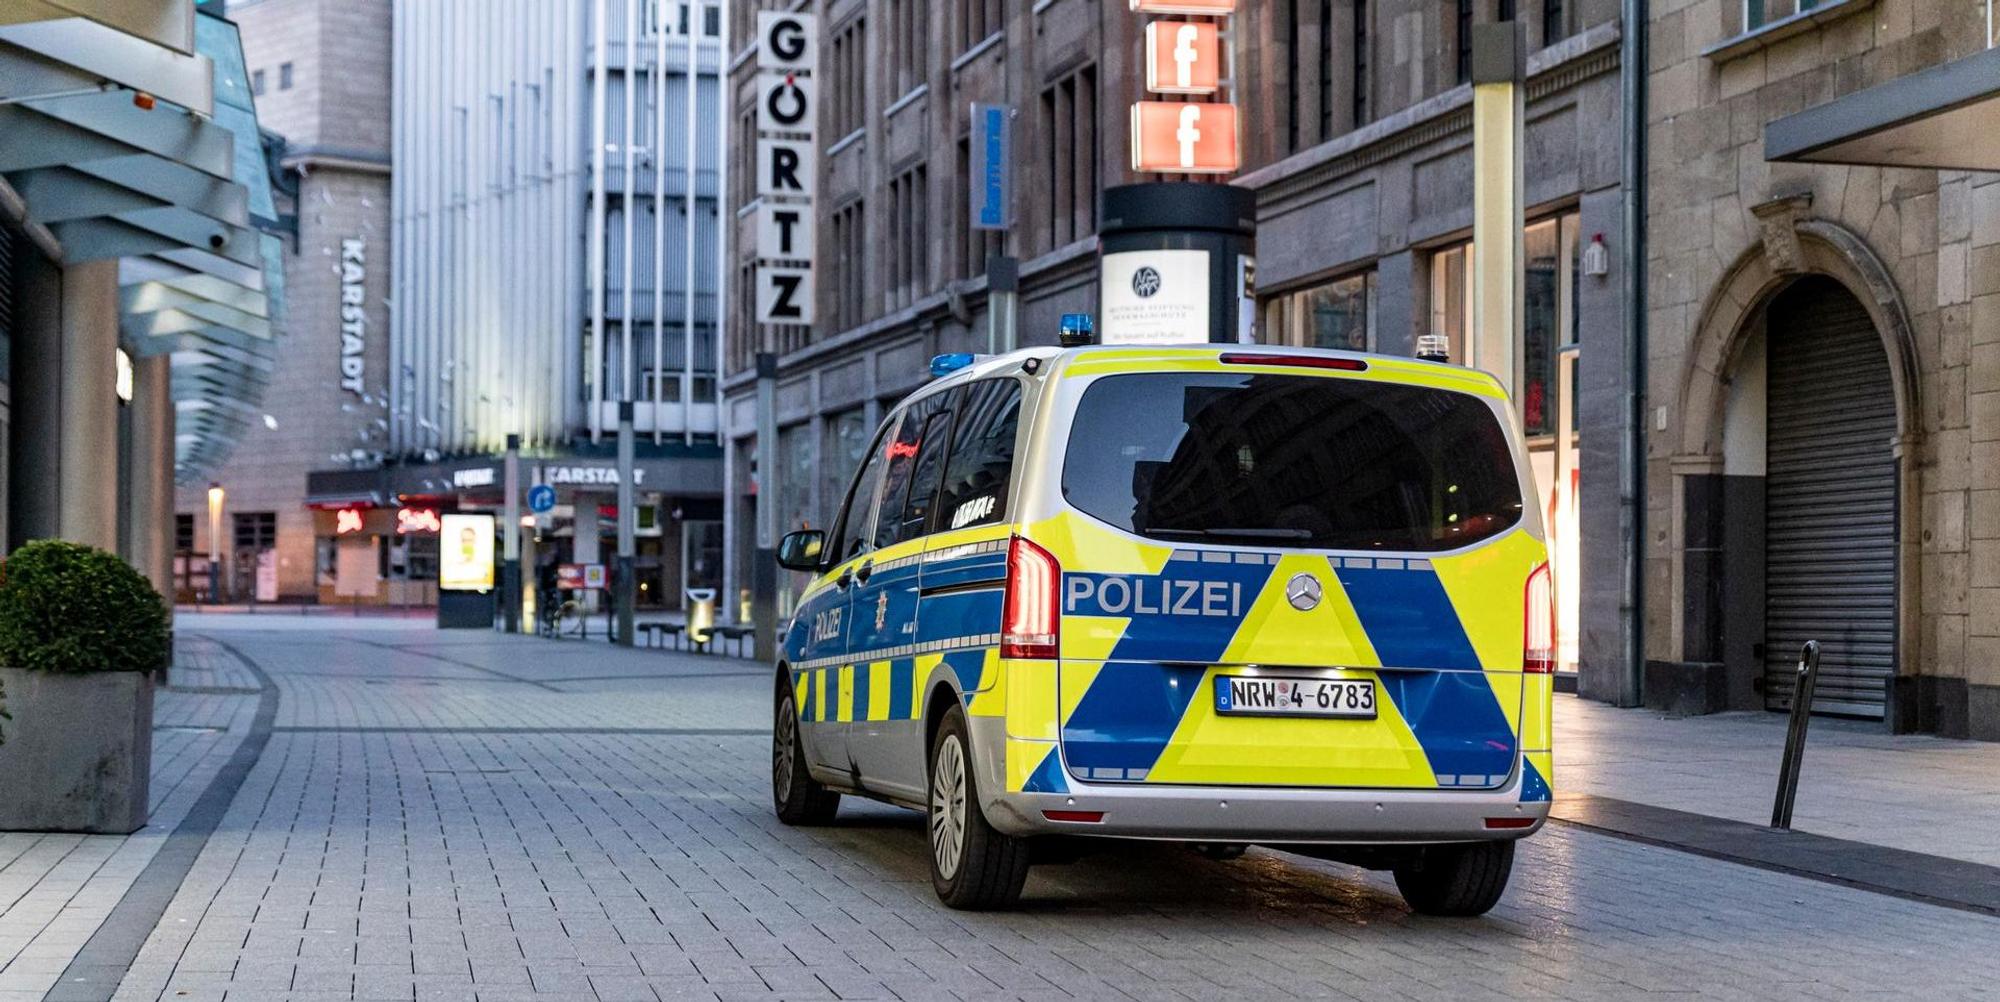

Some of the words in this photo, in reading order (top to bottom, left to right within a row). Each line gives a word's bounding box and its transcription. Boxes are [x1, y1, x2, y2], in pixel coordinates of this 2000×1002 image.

[1173, 24, 1198, 87] f
[1176, 104, 1200, 168] f
[341, 238, 365, 392] KARSTADT
[546, 466, 645, 484] KARSTAT
[1067, 576, 1241, 617] POLIZEI
[1221, 696, 1228, 705] D
[1231, 681, 1275, 707] NRW
[1291, 683, 1373, 709] 4-6783
